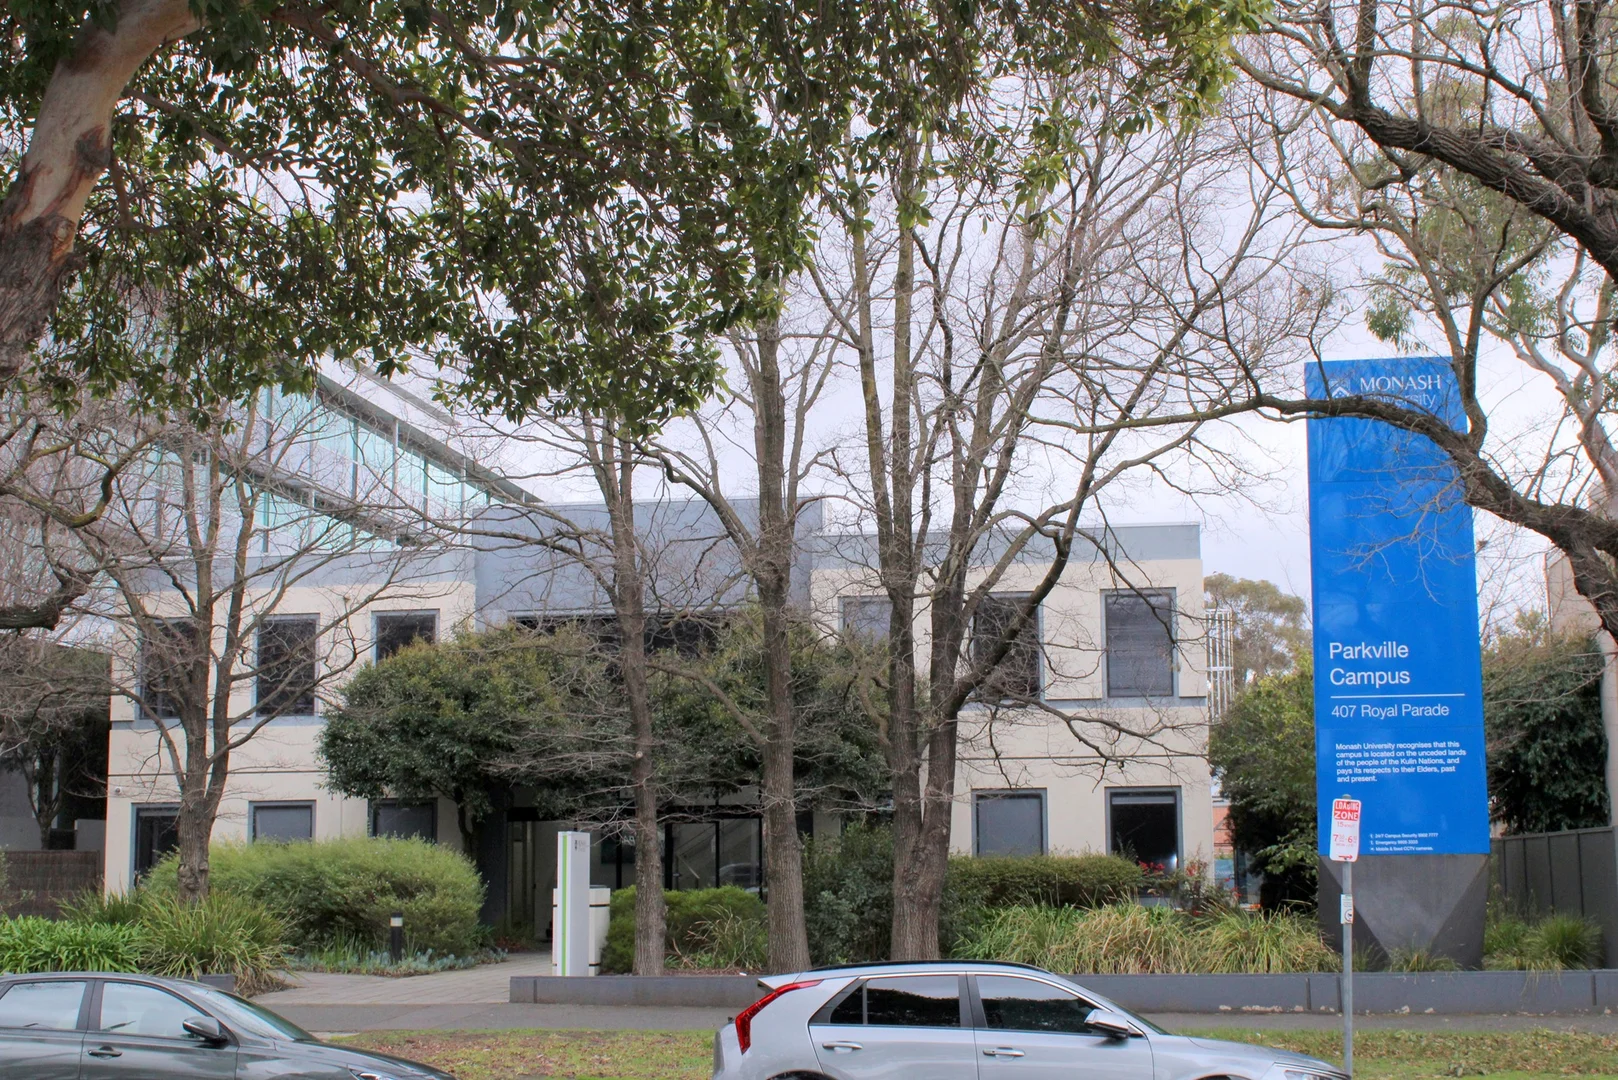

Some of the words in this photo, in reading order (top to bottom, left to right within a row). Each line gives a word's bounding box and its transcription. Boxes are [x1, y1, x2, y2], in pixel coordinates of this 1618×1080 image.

[1360, 374, 1441, 392] MONASH
[1361, 391, 1436, 409] niversity
[1329, 641, 1409, 659] Parkville
[1329, 668, 1411, 689] Campus
[1331, 705, 1357, 718] 407
[1361, 704, 1398, 720] Royal
[1401, 703, 1450, 717] Parade
[1363, 742, 1395, 750] University
[1396, 742, 1432, 750] recognises
[1447, 740, 1460, 748] this
[1370, 750, 1395, 758] located
[1418, 749, 1447, 757] unceded
[1448, 748, 1467, 756] lands
[1356, 759, 1379, 767] people
[1400, 757, 1417, 765] Kulin
[1418, 757, 1446, 765] Nations,
[1447, 756, 1460, 764] and
[1336, 768, 1353, 776] pays
[1363, 767, 1391, 775] respects
[1417, 765, 1440, 773] Elders,
[1440, 765, 1456, 773] past
[1336, 775, 1350, 783] and
[1350, 775, 1378, 784] present.
[1334, 810, 1358, 820] ZONE
